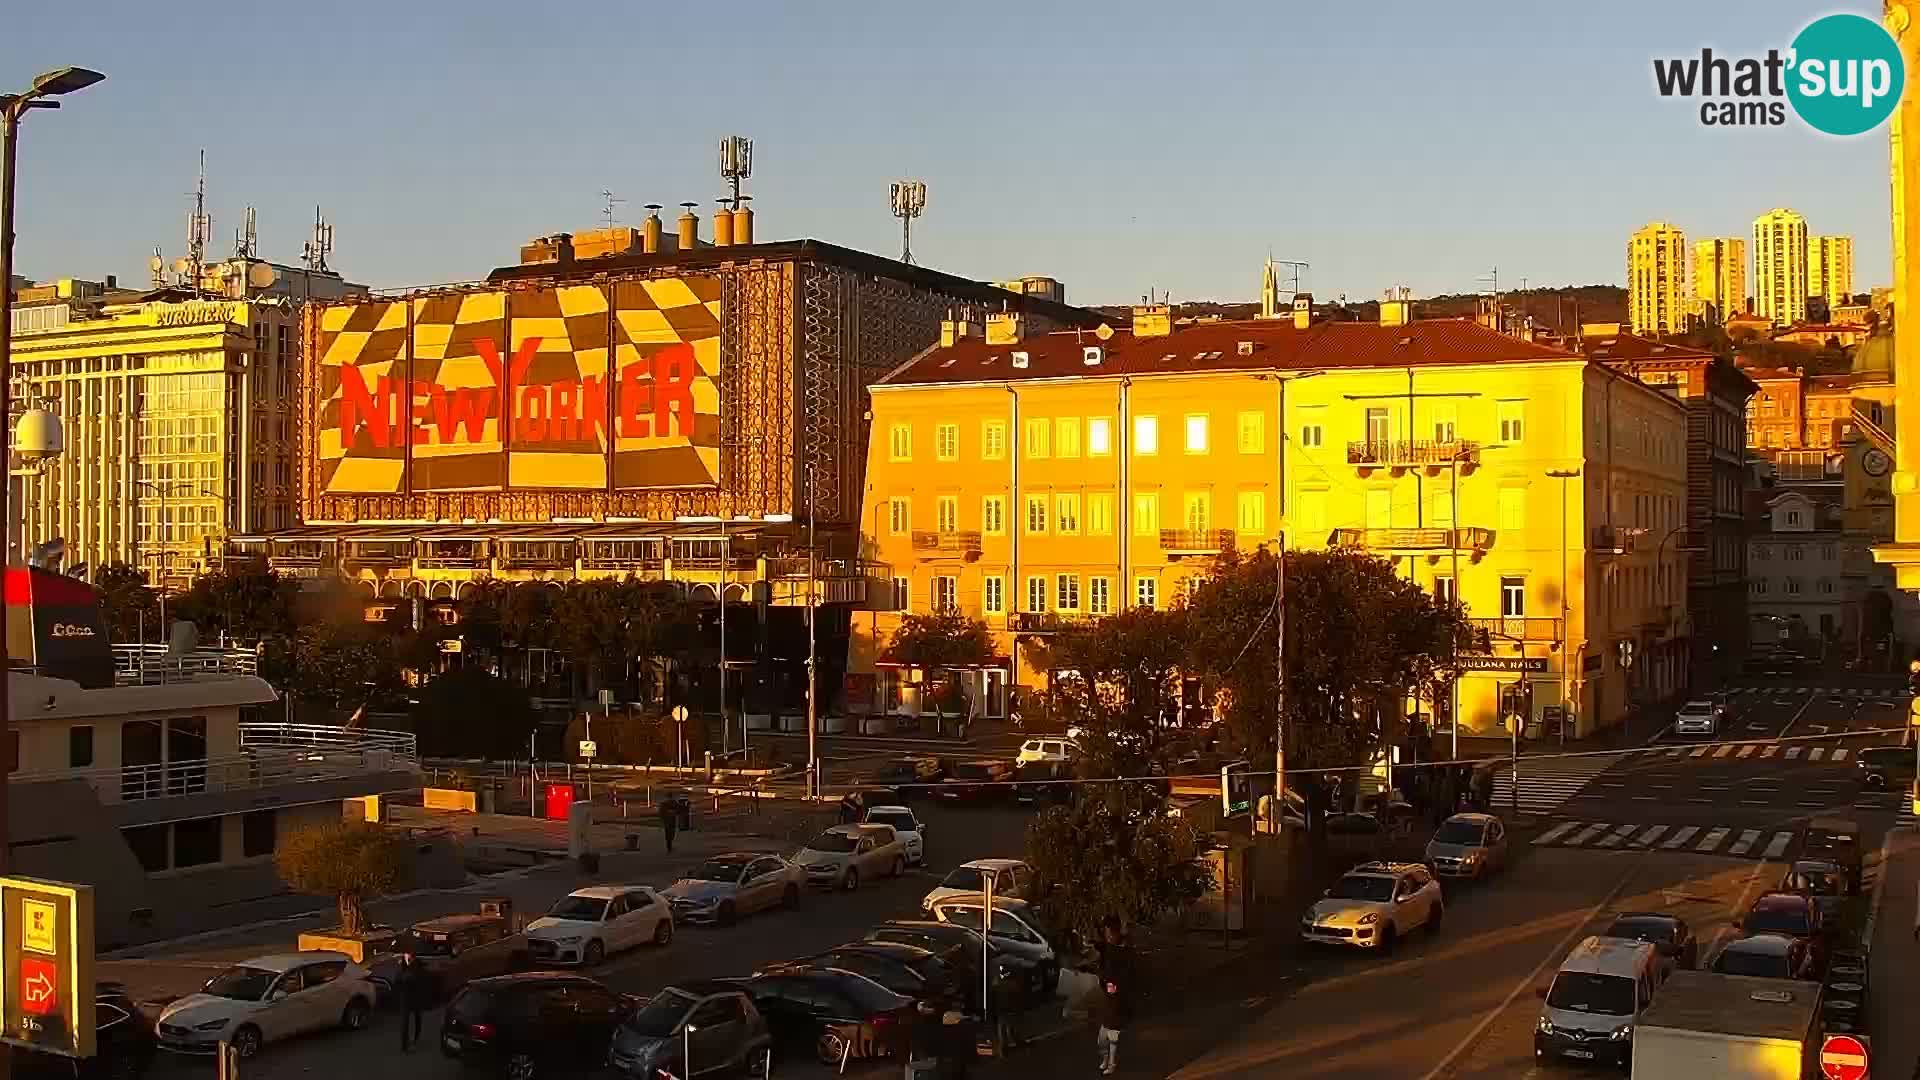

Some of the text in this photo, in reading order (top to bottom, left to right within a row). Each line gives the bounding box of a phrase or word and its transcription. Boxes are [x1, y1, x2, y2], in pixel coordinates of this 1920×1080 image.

[341, 337, 695, 448] NEW YORKER
[1460, 660, 1506, 669] JULIANA
